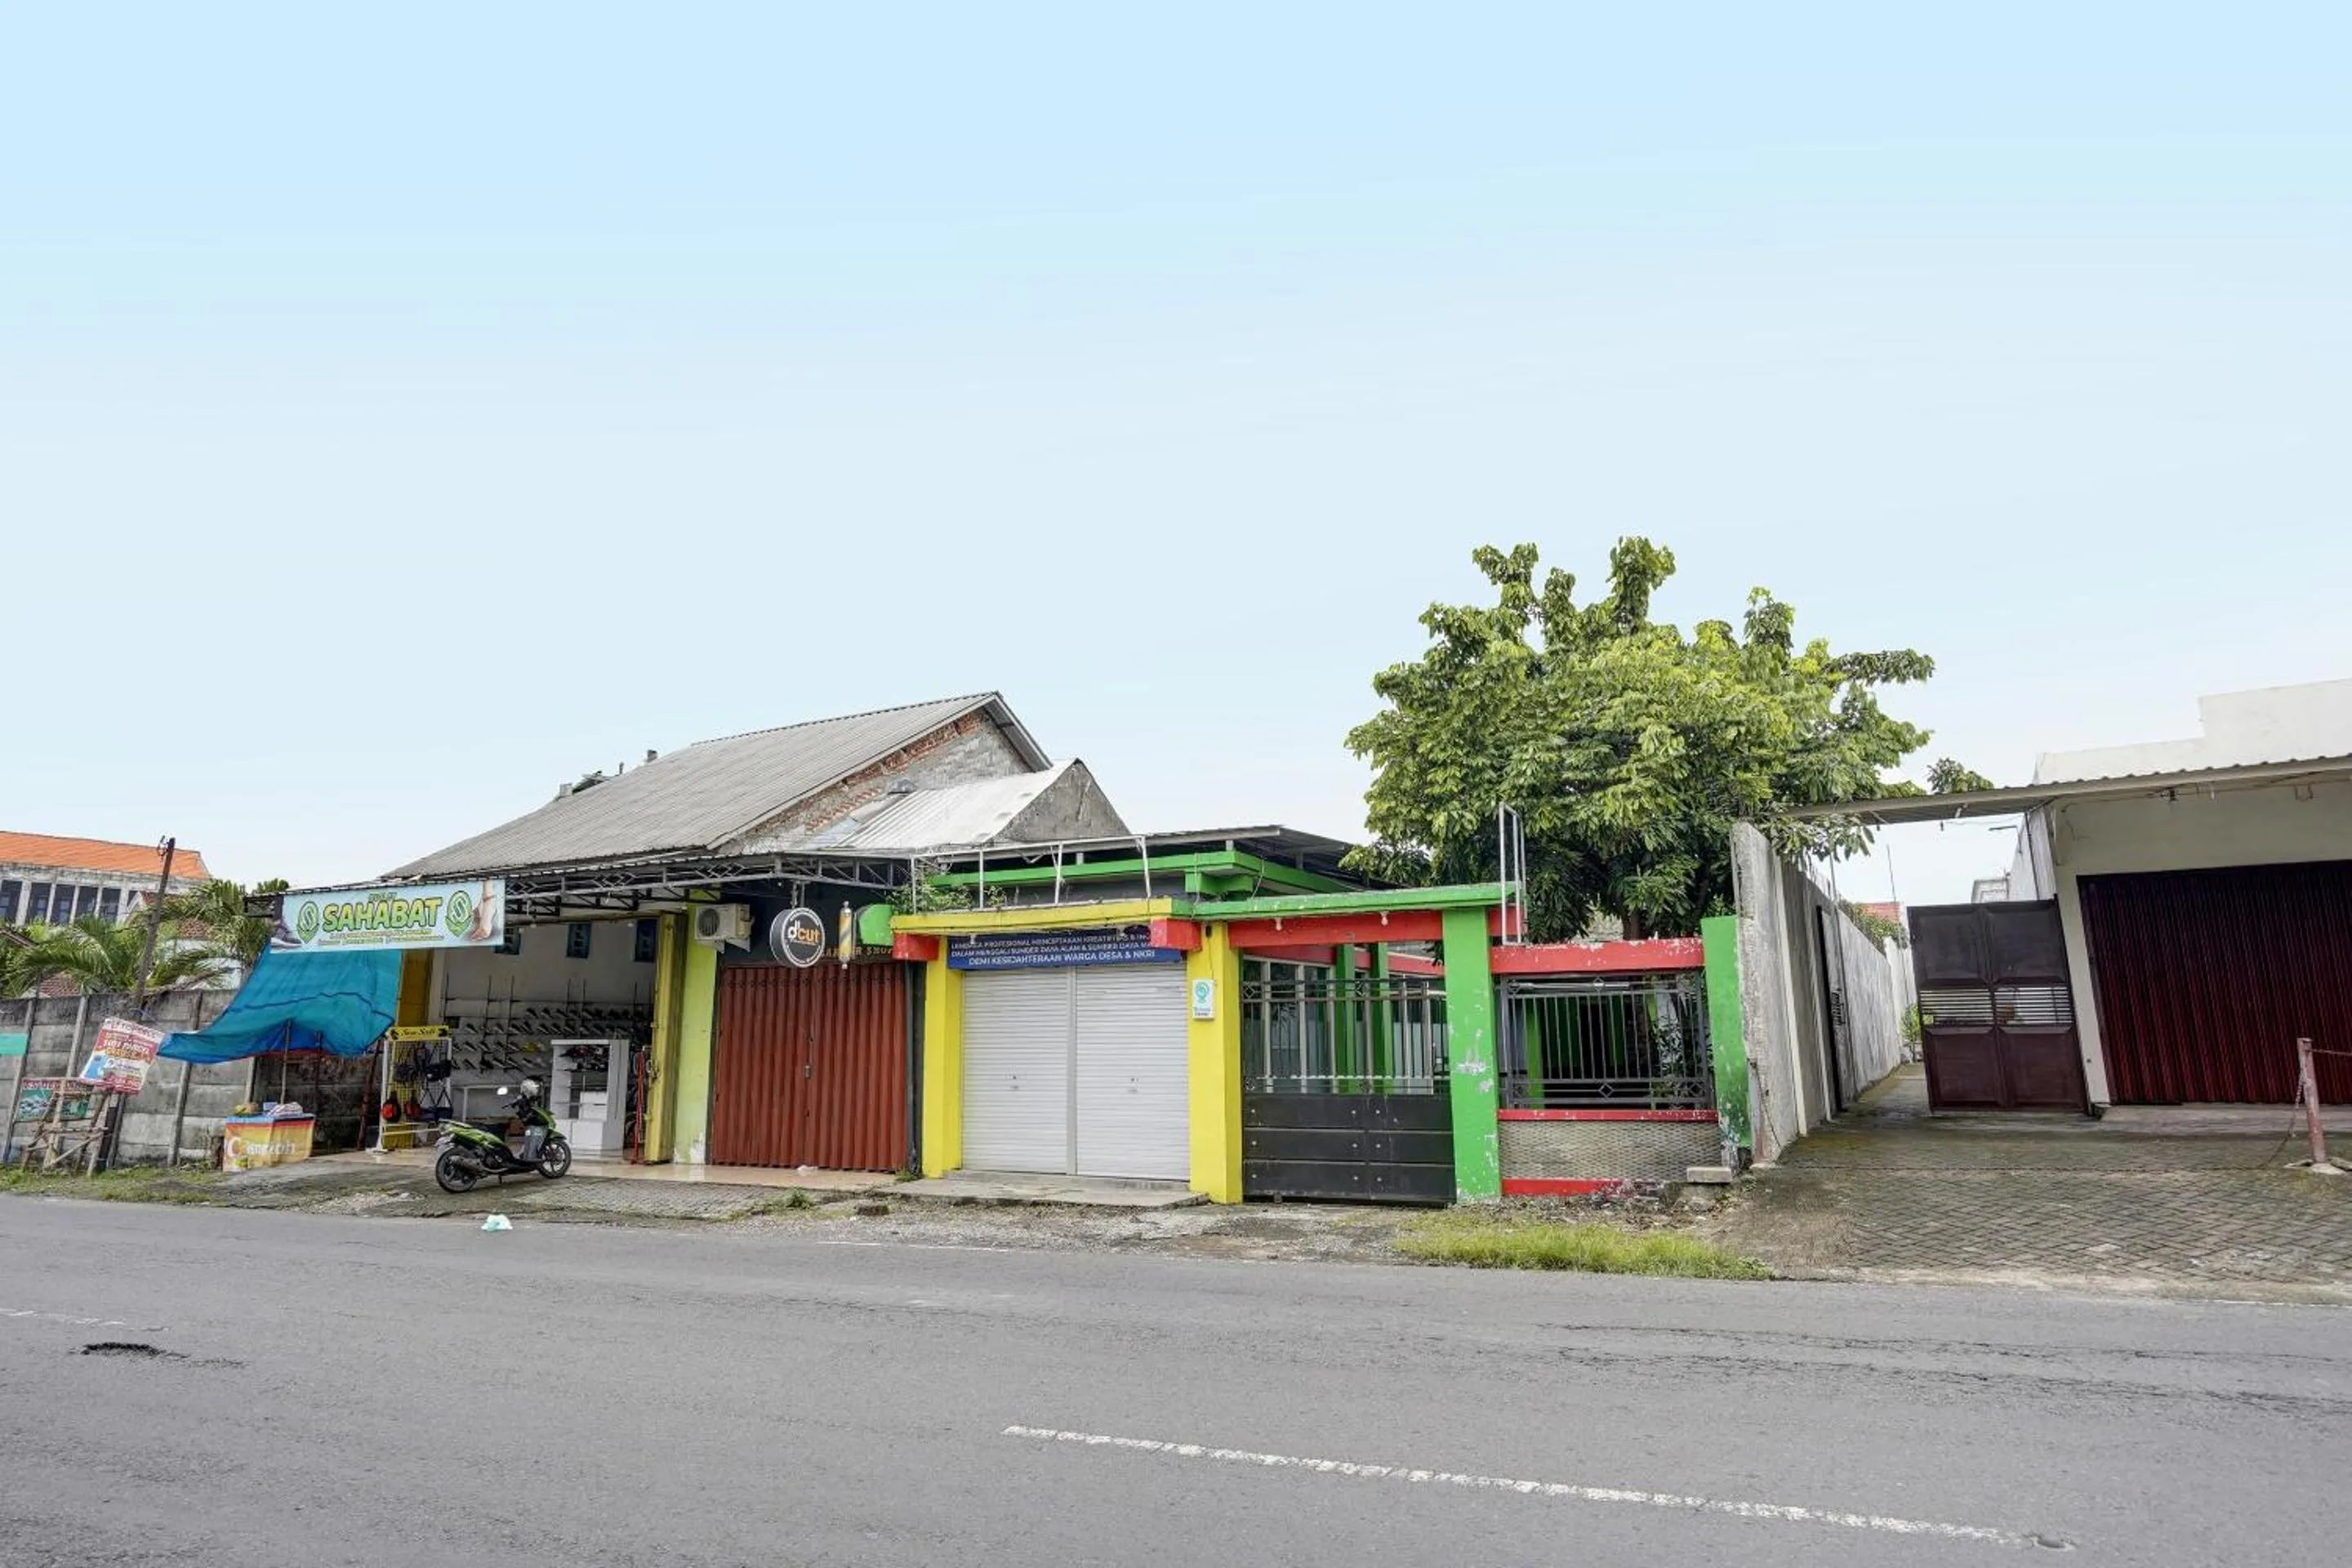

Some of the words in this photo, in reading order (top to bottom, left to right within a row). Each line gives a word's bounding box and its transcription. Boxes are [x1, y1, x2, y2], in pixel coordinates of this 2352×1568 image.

[323, 897, 443, 932] SAHABAT
[969, 957, 990, 965] DEMI
[1064, 952, 1098, 962] WARGA
[1098, 951, 1123, 960] DESA
